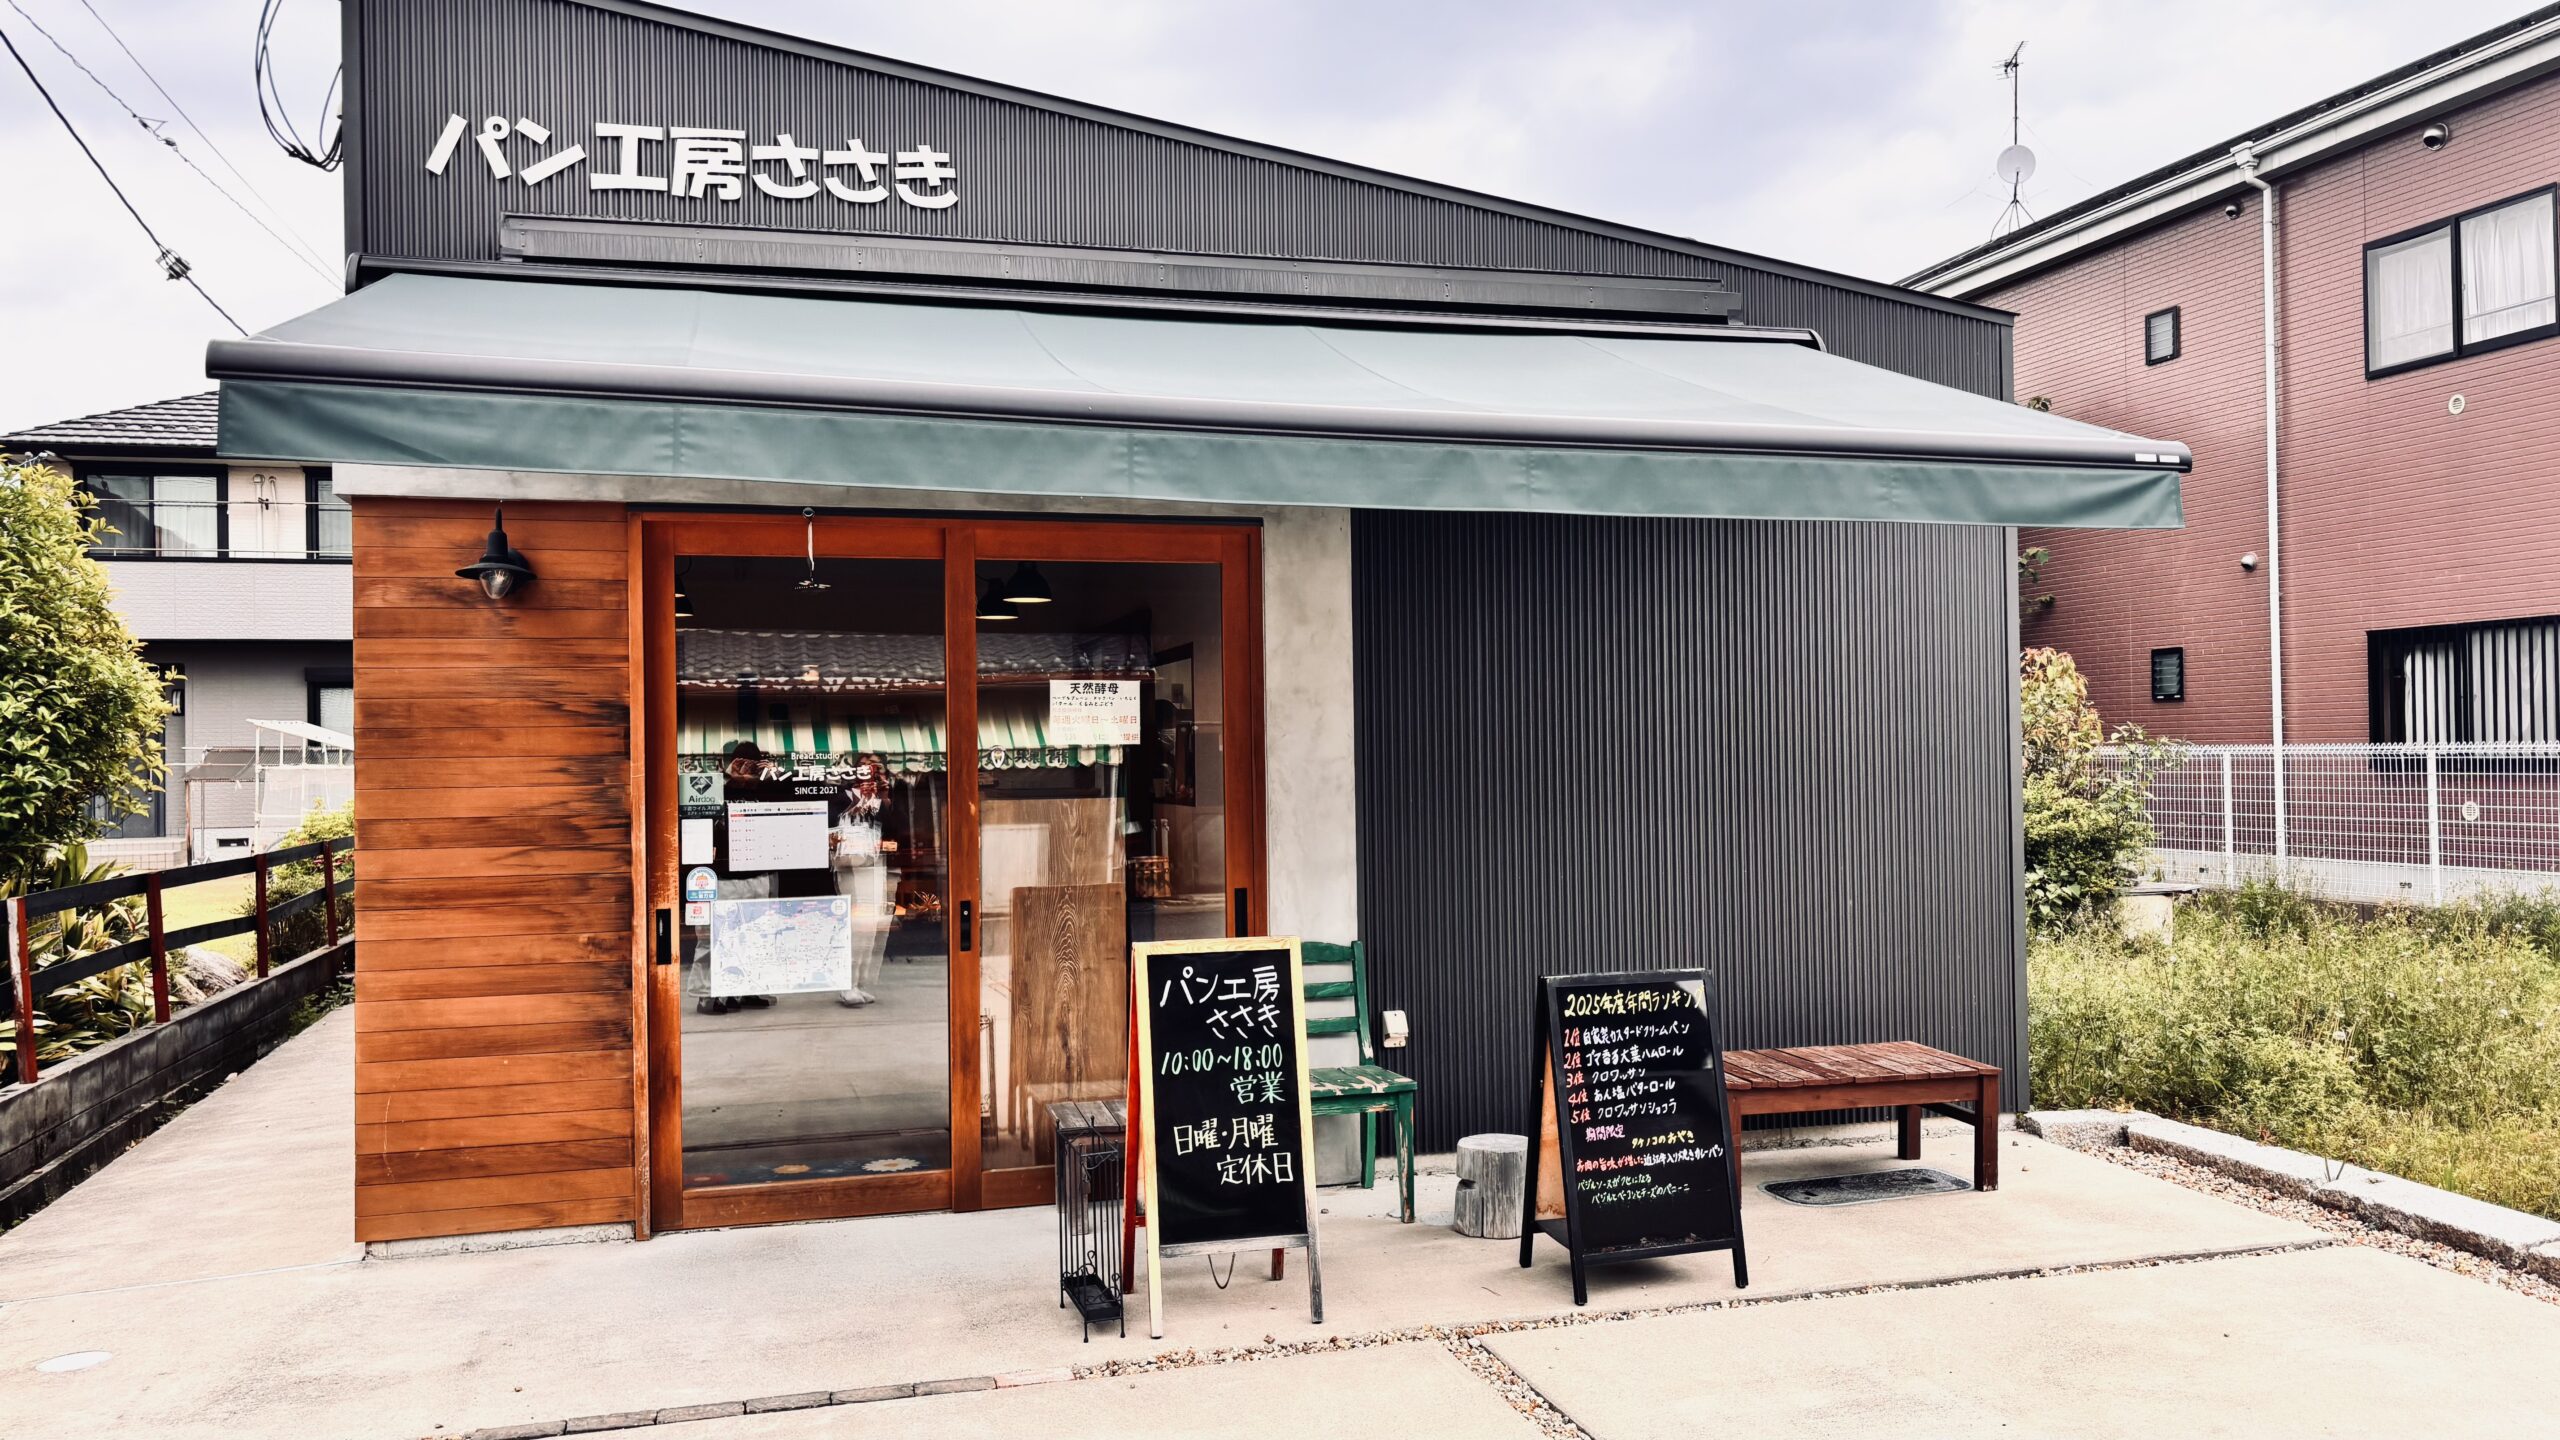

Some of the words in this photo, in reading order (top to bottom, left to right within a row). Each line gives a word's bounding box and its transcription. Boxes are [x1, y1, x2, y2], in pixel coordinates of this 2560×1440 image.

[425, 113, 959, 209] パン工房ささき
[1069, 682, 1119, 694] 天然酵母
[791, 751, 814, 760] Bread
[815, 751, 840, 760] studio
[759, 764, 872, 781] パン工房ささき
[688, 795, 716, 805] Airdog
[794, 786, 818, 796] SINCE
[819, 785, 838, 795] 2021
[1160, 964, 1281, 1007] パン工房
[1564, 986, 1704, 1017] 2025年度年間ランキング
[1205, 1003, 1281, 1039] ささき
[1161, 1043, 1283, 1075] 10:00~18:00
[1230, 1071, 1287, 1105] 営業
[1566, 1070, 1584, 1088] 3位
[1592, 1067, 1646, 1084] クロワッサン
[1568, 1088, 1589, 1107] 4位
[1570, 1107, 1591, 1124] 5位
[1597, 1098, 1677, 1120] クロワッサンショコラ
[1173, 1113, 1278, 1156] 日曜・月曜
[1585, 1123, 1626, 1142] 期間限定
[1631, 1130, 1696, 1149] タケノコのおやき
[1216, 1152, 1295, 1186] 定休日
